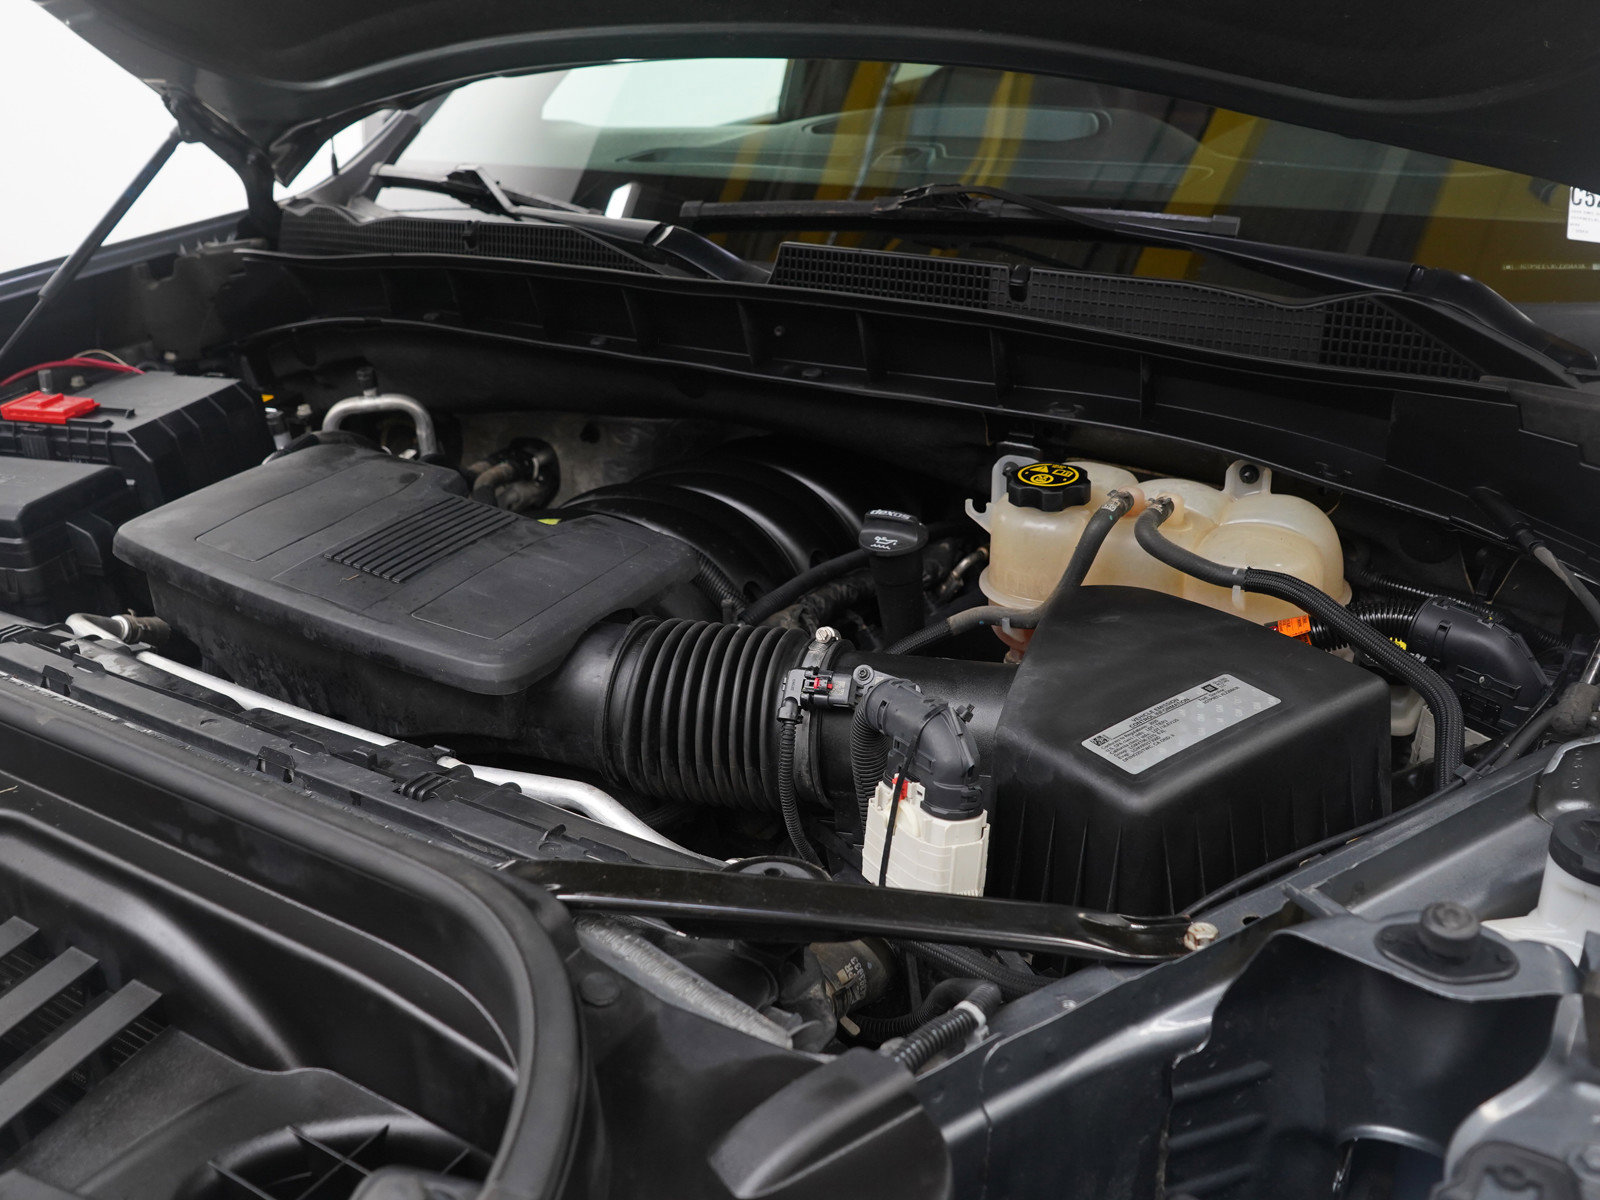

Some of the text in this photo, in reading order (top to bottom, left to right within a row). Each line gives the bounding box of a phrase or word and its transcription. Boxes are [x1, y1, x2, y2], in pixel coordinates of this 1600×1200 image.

[869, 509, 911, 520] dexos
[1128, 698, 1190, 729] CONTROL INFORMATION
[1131, 698, 1180, 722] VEHICLE EMISSION
